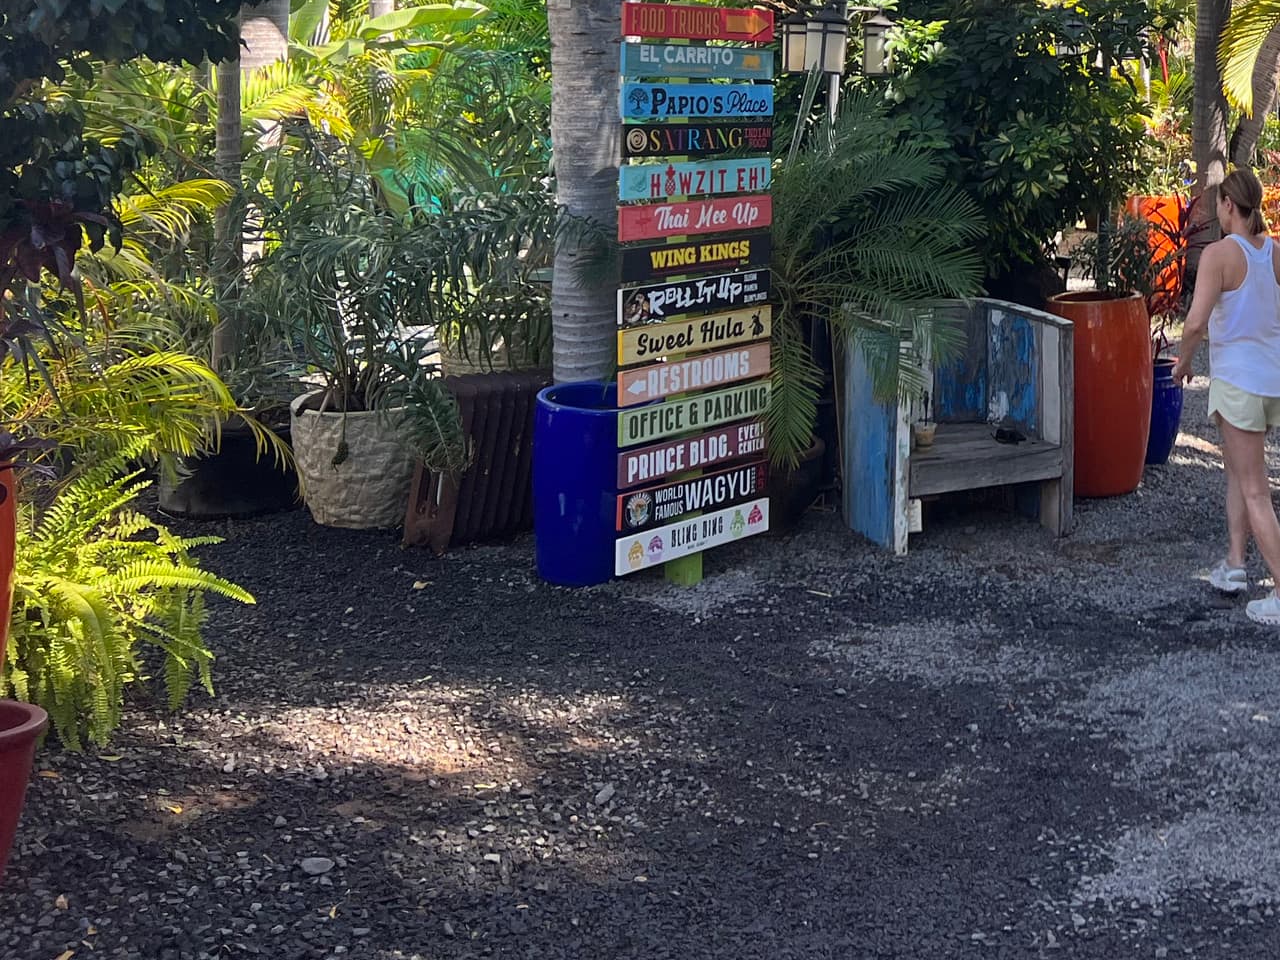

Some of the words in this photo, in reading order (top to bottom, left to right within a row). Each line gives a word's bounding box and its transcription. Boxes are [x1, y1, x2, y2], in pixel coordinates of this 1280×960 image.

[632, 6, 666, 33] FOOD
[671, 9, 720, 36] TRUCKS
[639, 45, 660, 63] EL
[663, 46, 734, 65] CARRITO
[650, 88, 723, 115] PAPIO'S
[726, 90, 769, 114] Place
[649, 127, 743, 152] SATRANG
[744, 127, 771, 138] INDIAN
[736, 167, 766, 192] EH!
[654, 206, 690, 231] Thai
[695, 204, 728, 229] Mee
[731, 202, 759, 226] Up
[650, 247, 697, 270] WING
[700, 240, 750, 263] KINGS
[636, 324, 694, 356] Sweet
[700, 317, 745, 344] Hula
[647, 350, 750, 398] RESTROOMS
[629, 404, 684, 440] OFFICE
[704, 387, 767, 423] PARKING
[738, 421, 764, 441] EVENT
[627, 444, 685, 483] PRINCE
[689, 434, 733, 467] BLDG.
[738, 437, 765, 455] CENTER
[655, 484, 684, 504] WORLD
[684, 468, 751, 511] WAGYU
[655, 500, 684, 521] FAMOUS
